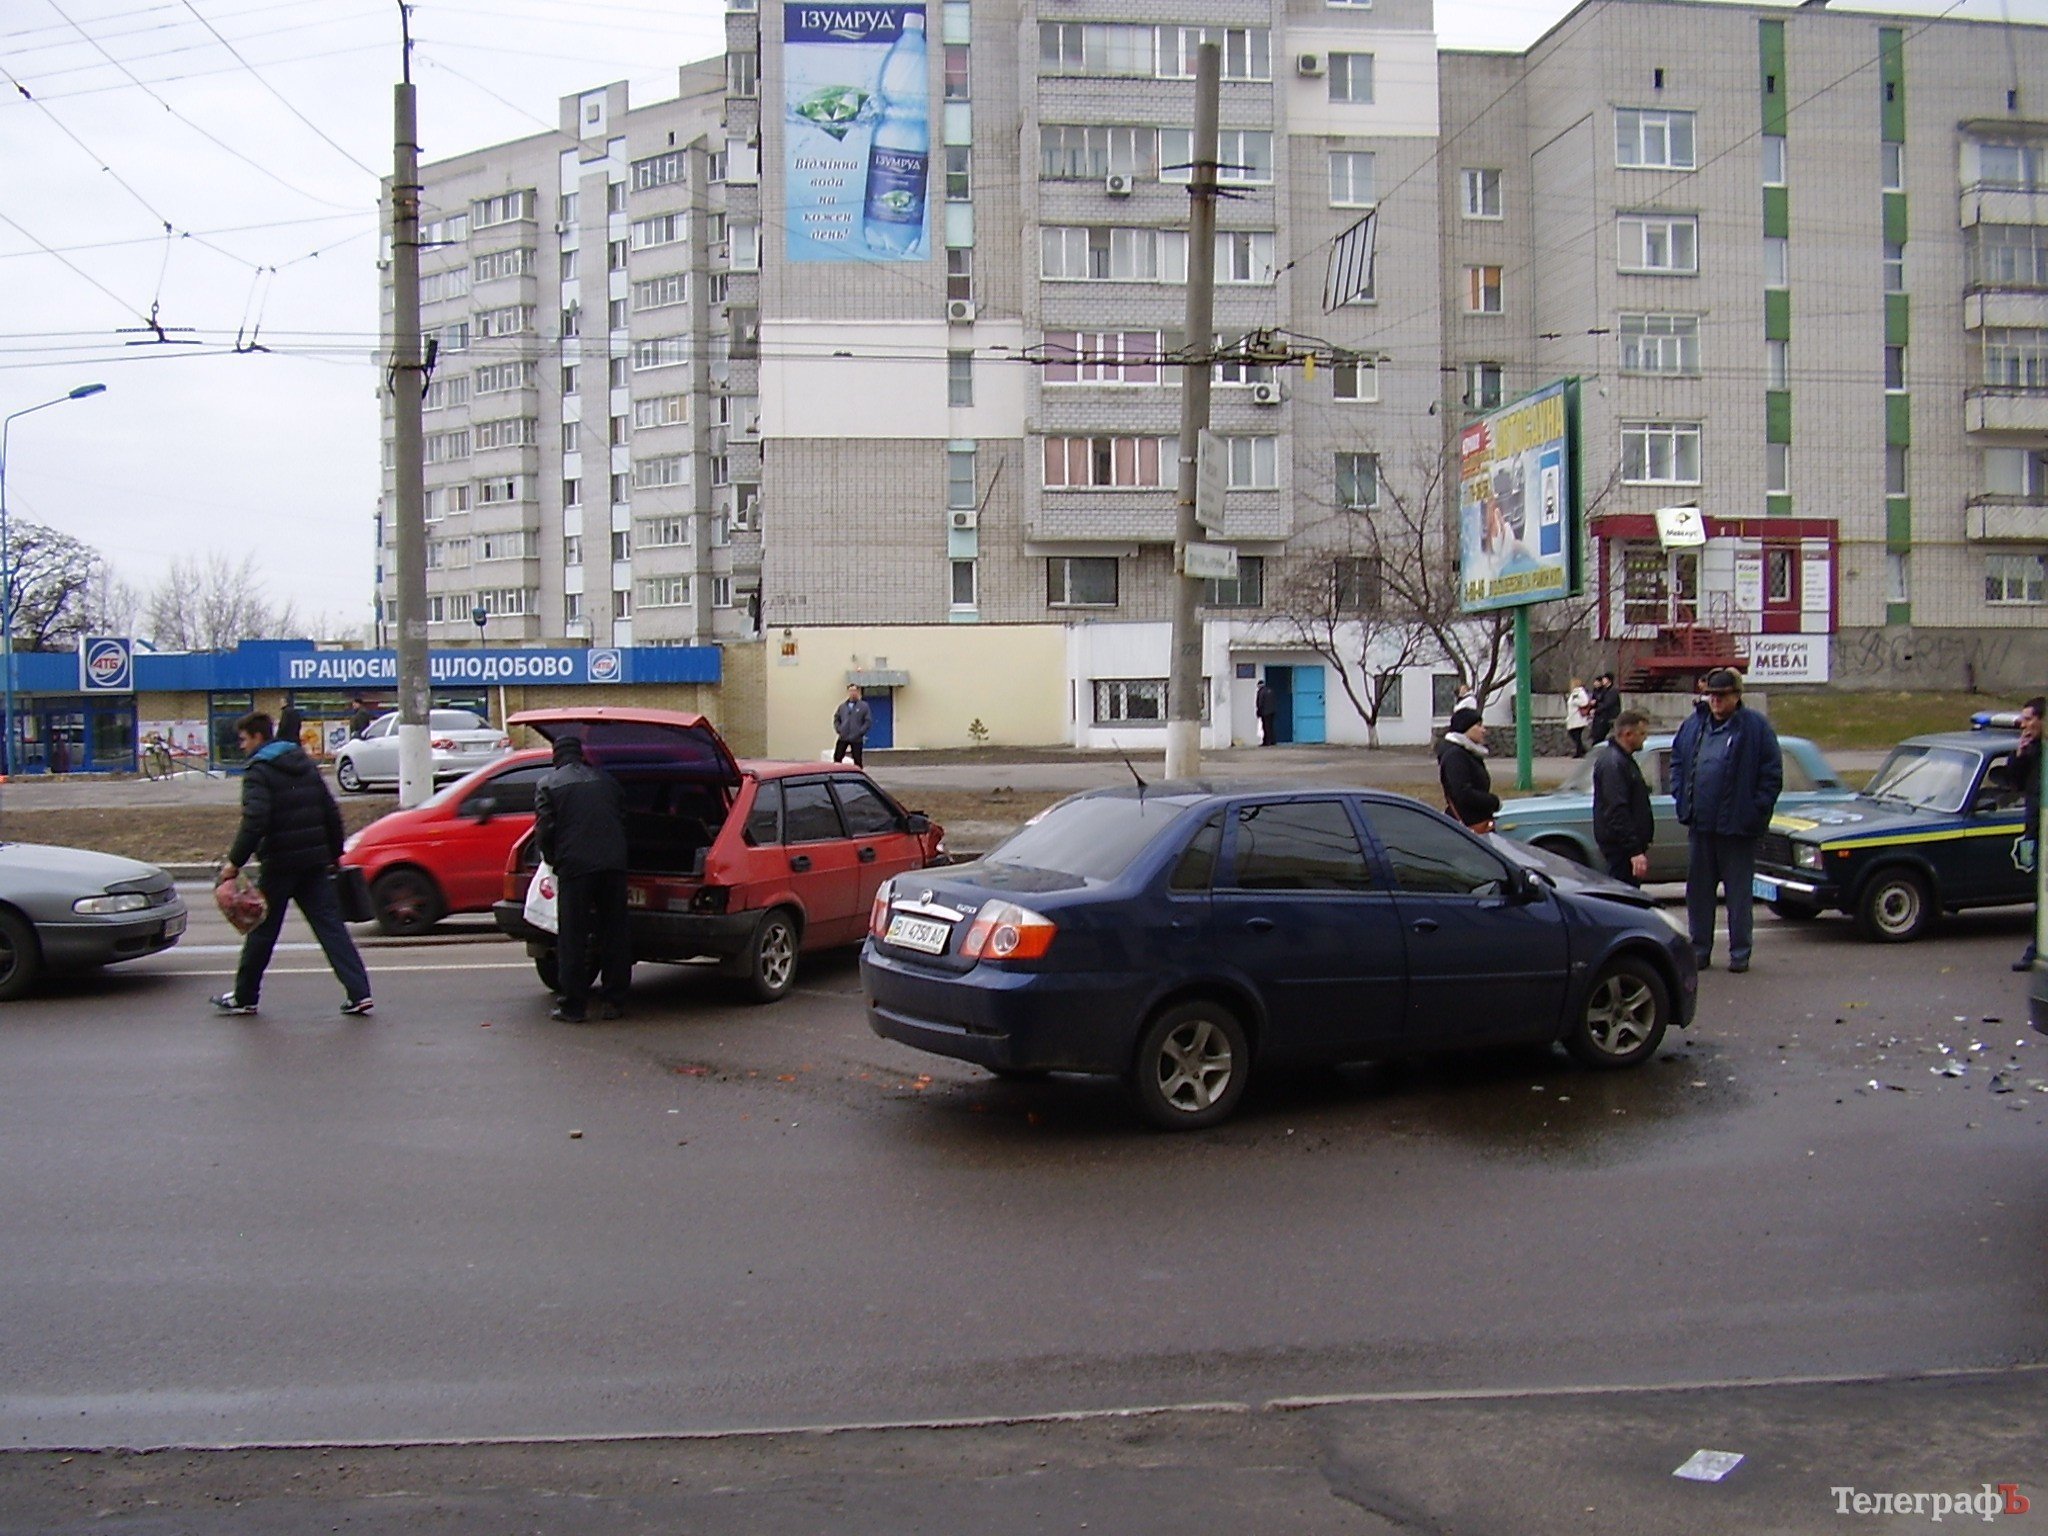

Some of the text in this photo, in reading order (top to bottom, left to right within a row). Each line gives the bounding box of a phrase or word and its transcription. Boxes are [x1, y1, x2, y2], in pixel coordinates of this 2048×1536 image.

[801, 10, 895, 31] ІЗУМРУД
[795, 157, 858, 170] Відмінна
[875, 155, 921, 170] ІЗУМРУД
[810, 177, 844, 187] вода
[819, 196, 836, 206] на
[804, 213, 852, 223] кожен
[811, 228, 849, 240] день!
[92, 657, 119, 670] АТБ
[1756, 654, 1808, 668] МЕБЛІ
[290, 656, 573, 682] ПРАЦЮЄМ ЦІЛОДОБОВО
